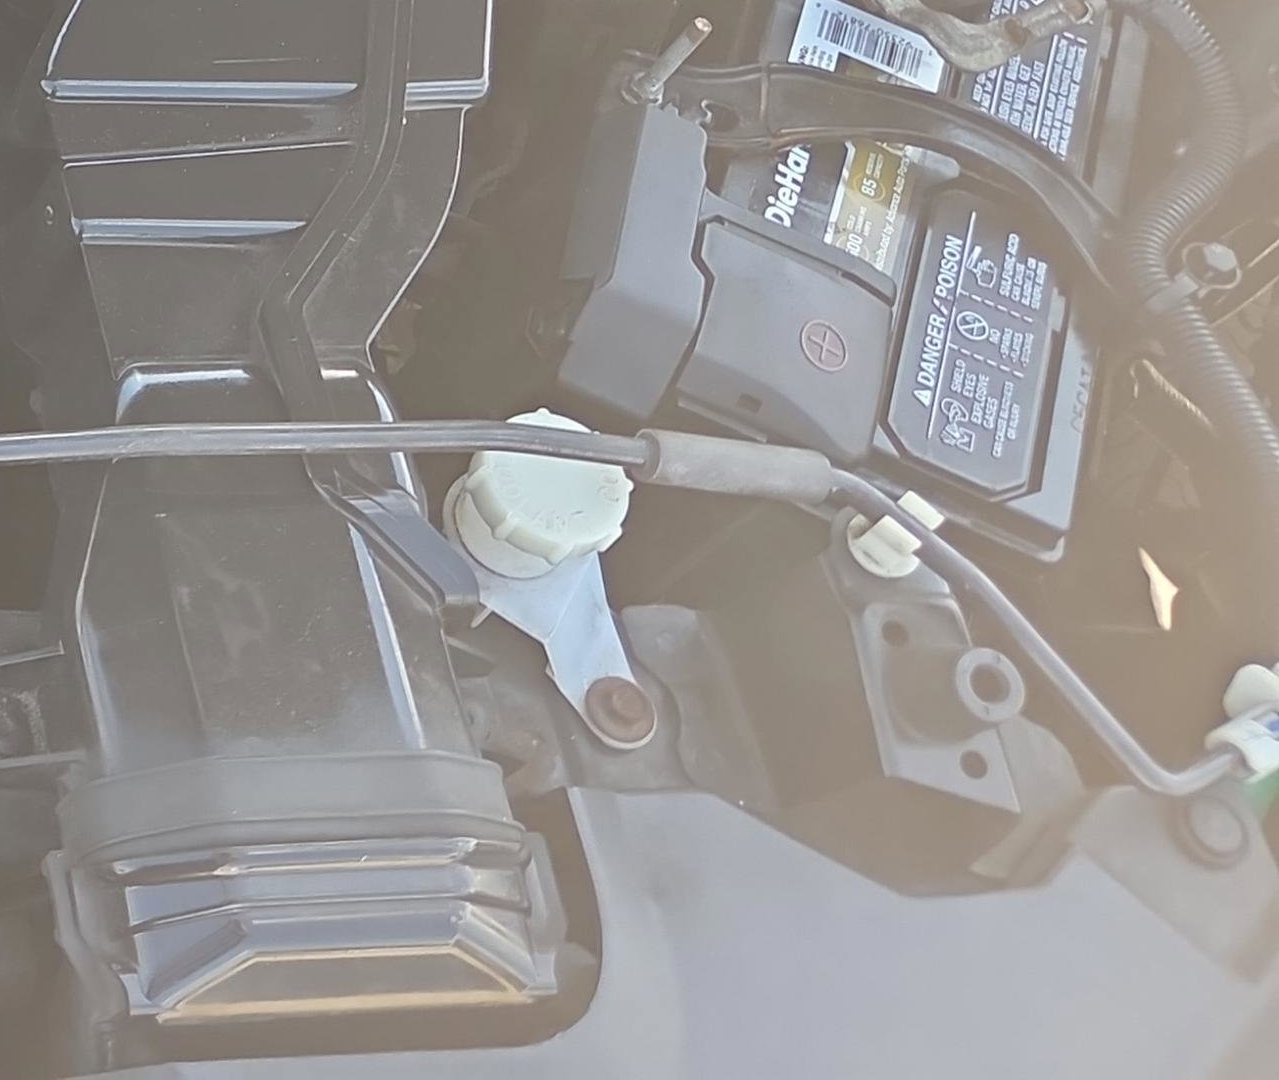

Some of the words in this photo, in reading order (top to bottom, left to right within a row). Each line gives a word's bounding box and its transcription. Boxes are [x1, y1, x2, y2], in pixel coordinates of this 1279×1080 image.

[1018, 64, 1030, 81] GET
[1031, 60, 1044, 81] FAST
[1026, 81, 1040, 103] HELP
[764, 144, 811, 228] DieHar
[860, 177, 877, 197] 85
[874, 234, 891, 269] istributed
[892, 175, 904, 194] Auto
[1006, 232, 1019, 254] ACID
[998, 253, 1016, 297] SULFURIC
[917, 313, 946, 387] DANGER
[935, 234, 962, 298] POISON
[989, 328, 1000, 344] NO
[950, 358, 967, 393] SHIELD
[962, 372, 976, 397] EYES
[970, 373, 990, 424] EXPLOSIVE
[982, 396, 998, 429] GASES
